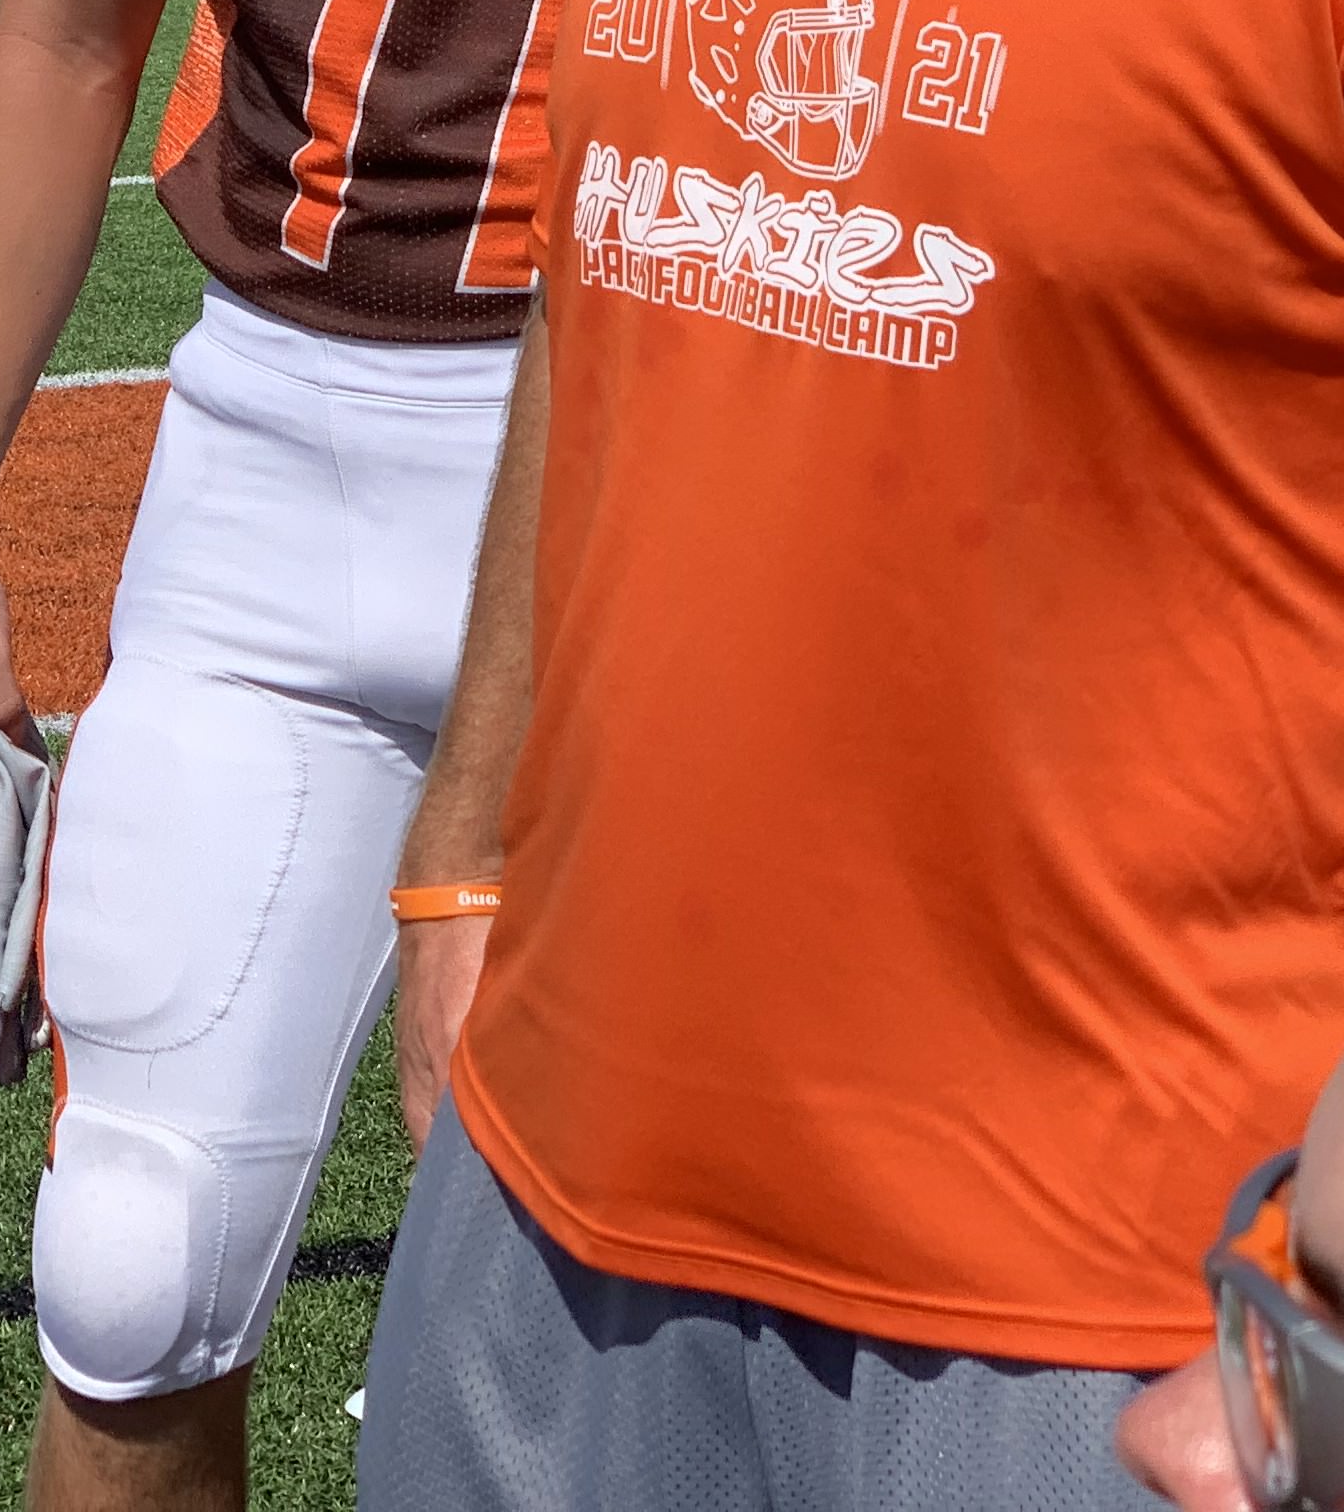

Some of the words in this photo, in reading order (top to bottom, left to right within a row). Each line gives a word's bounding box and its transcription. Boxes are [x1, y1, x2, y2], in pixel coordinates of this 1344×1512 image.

[902, 21, 1002, 136] 21
[651, 254, 822, 348] FOOTBALL
[823, 300, 959, 370] CAMP
